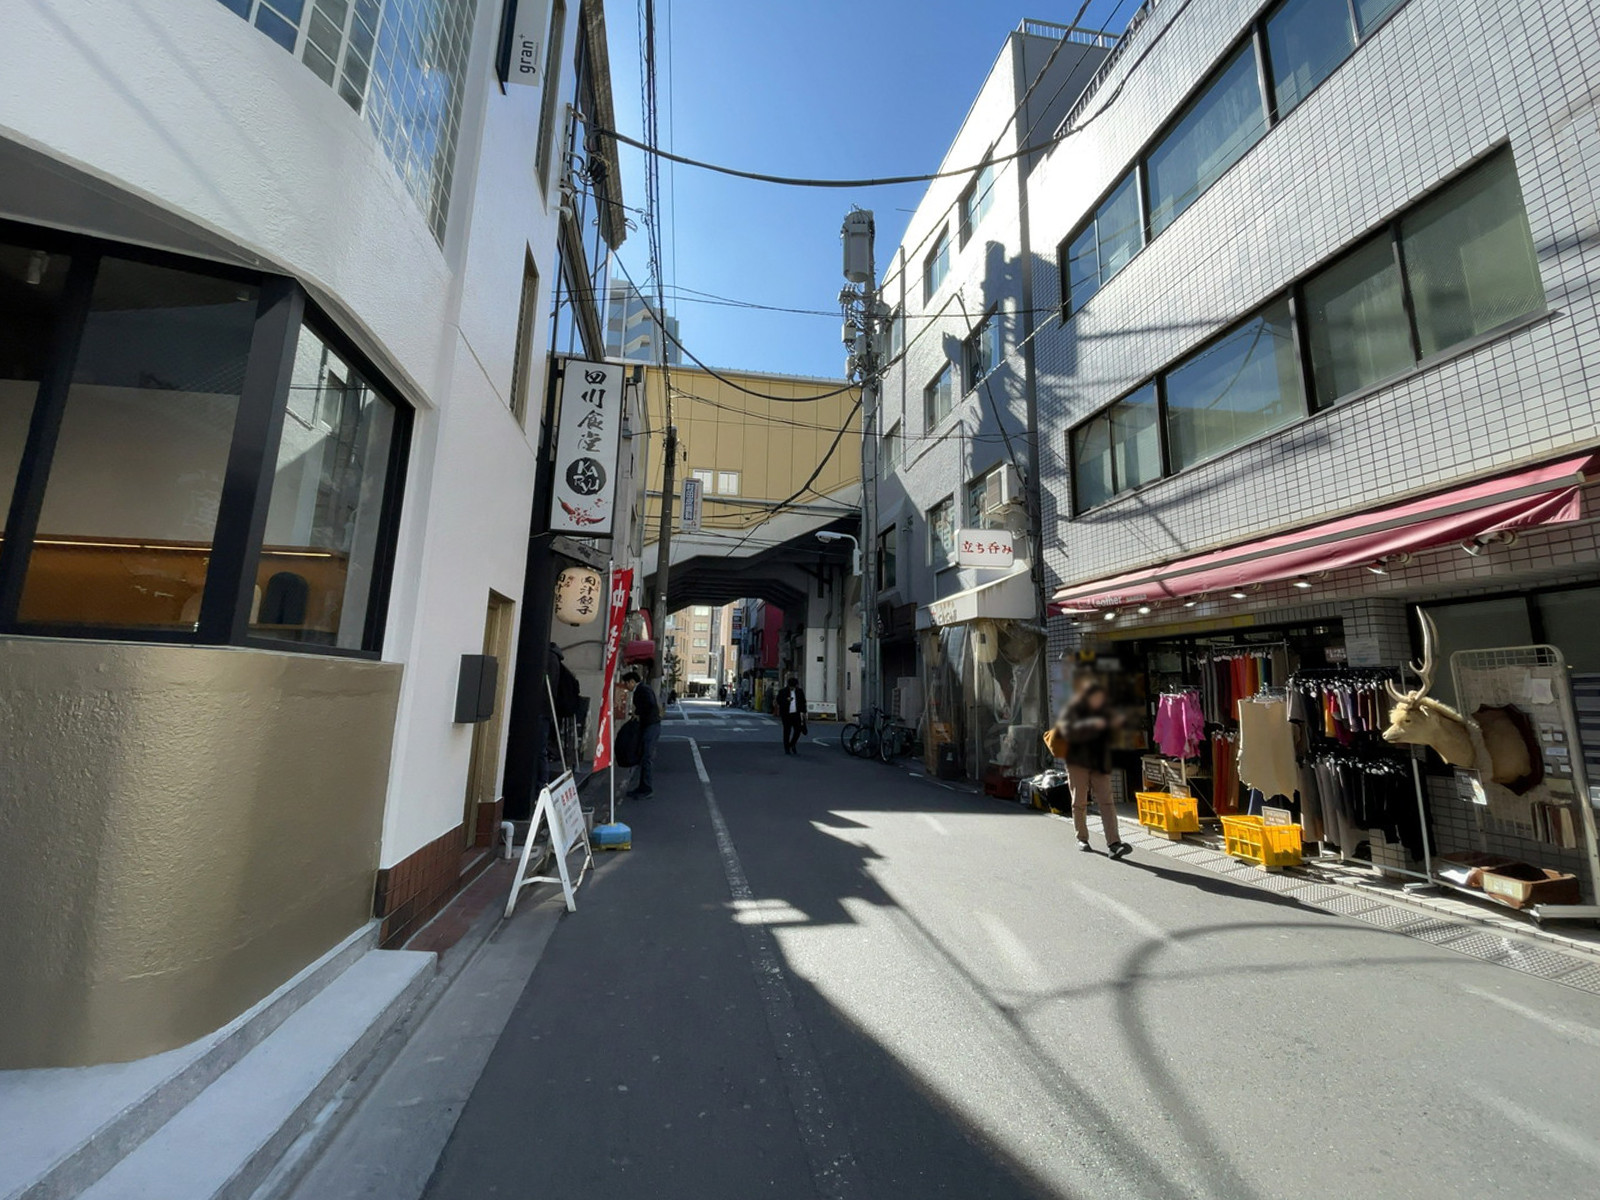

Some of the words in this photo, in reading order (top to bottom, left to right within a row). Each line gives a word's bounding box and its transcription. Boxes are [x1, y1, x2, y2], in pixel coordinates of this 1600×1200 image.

[576, 368, 607, 453] 田川食堂
[961, 540, 1013, 555] 立ち呑み
